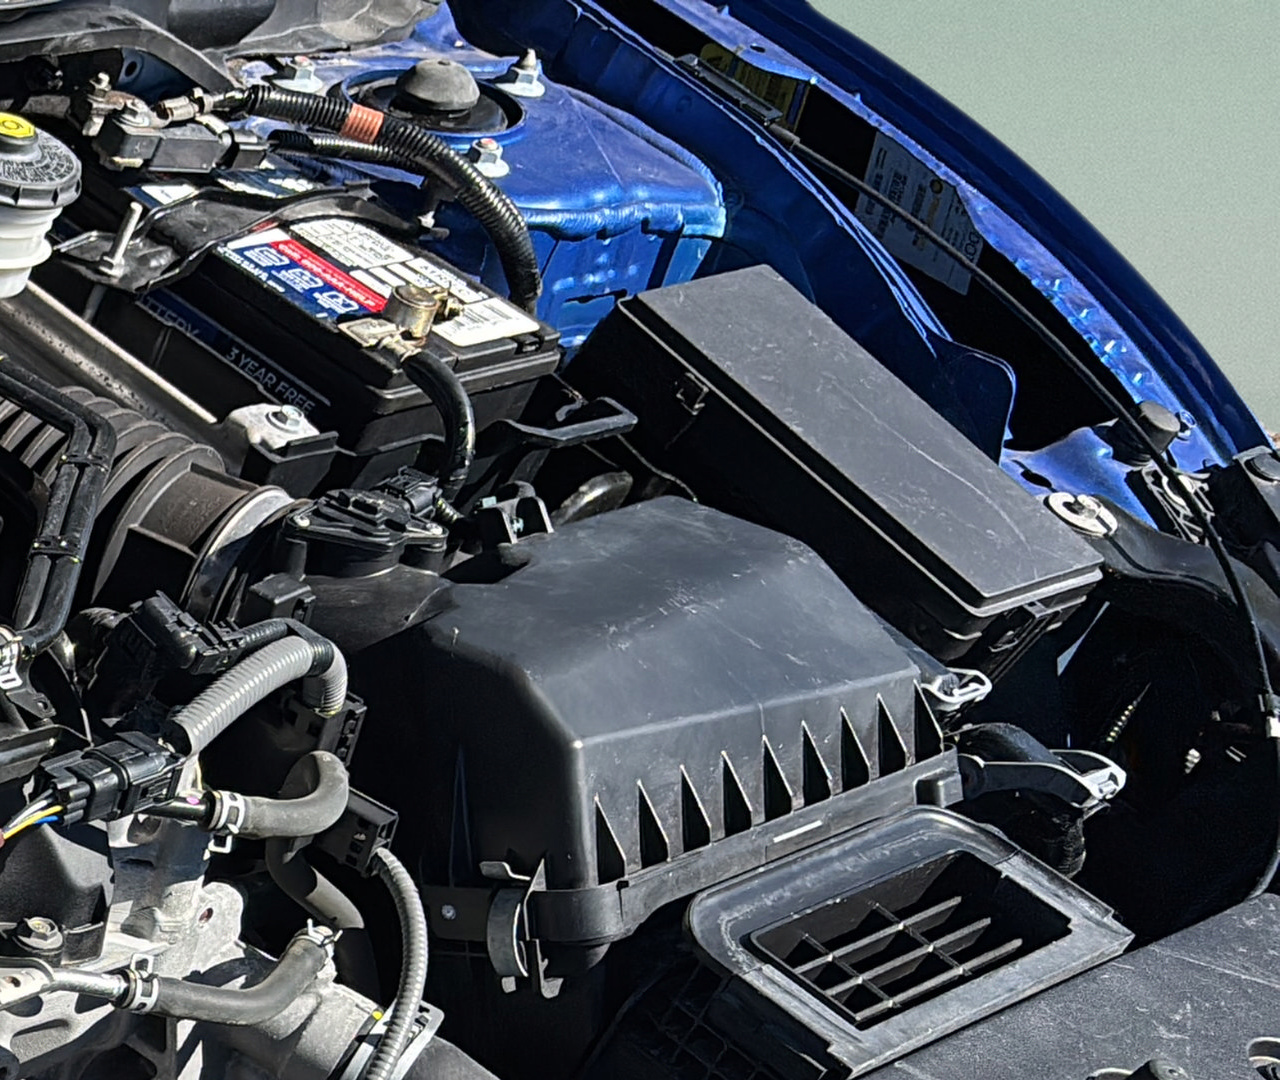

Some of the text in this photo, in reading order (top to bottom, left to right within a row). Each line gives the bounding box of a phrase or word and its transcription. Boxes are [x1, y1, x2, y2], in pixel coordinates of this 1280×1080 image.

[225, 346, 316, 413] 3 YEAR FREE
